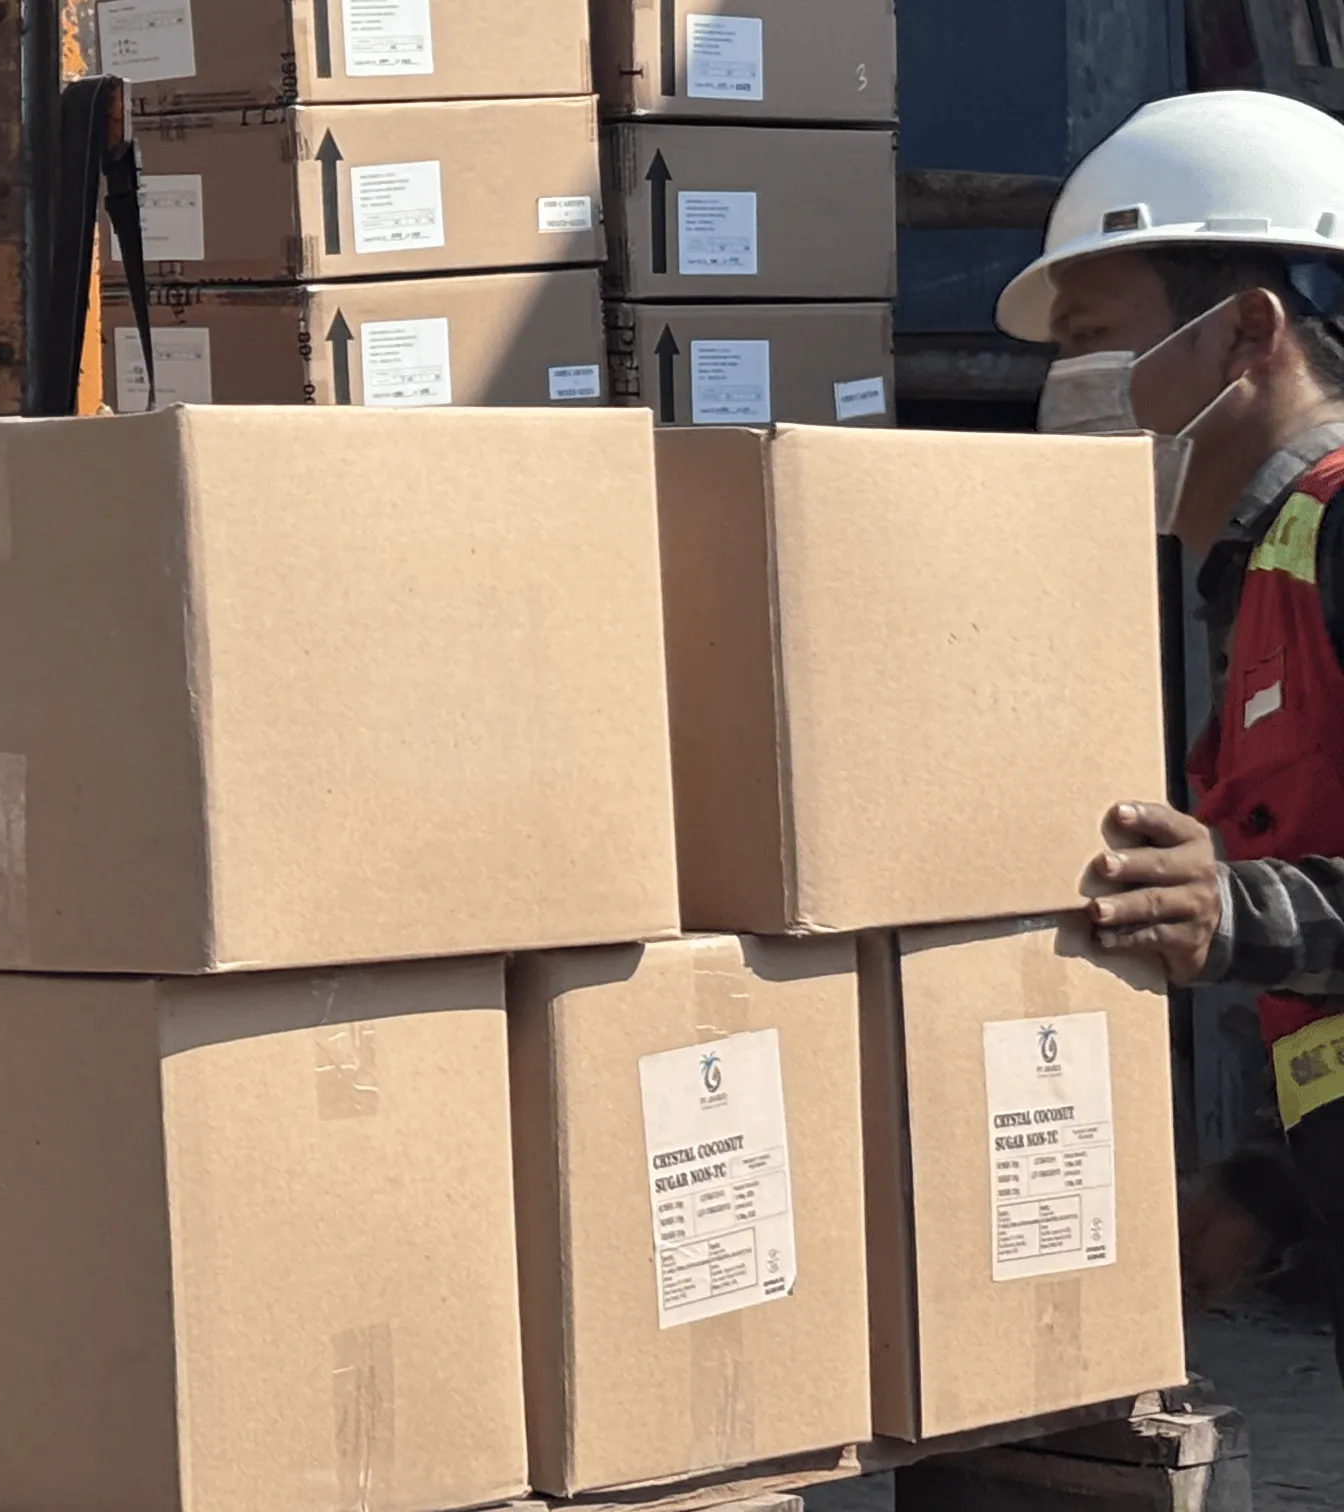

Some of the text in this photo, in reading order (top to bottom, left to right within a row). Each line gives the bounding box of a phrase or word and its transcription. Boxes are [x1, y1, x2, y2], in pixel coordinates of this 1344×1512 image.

[994, 1106, 1075, 1129] CRYSTAL COCONUT
[652, 1135, 744, 1170] CRYSTAL COCONUT
[994, 1134, 1025, 1151] SUGAR
[655, 1173, 689, 1193] SUGAR
